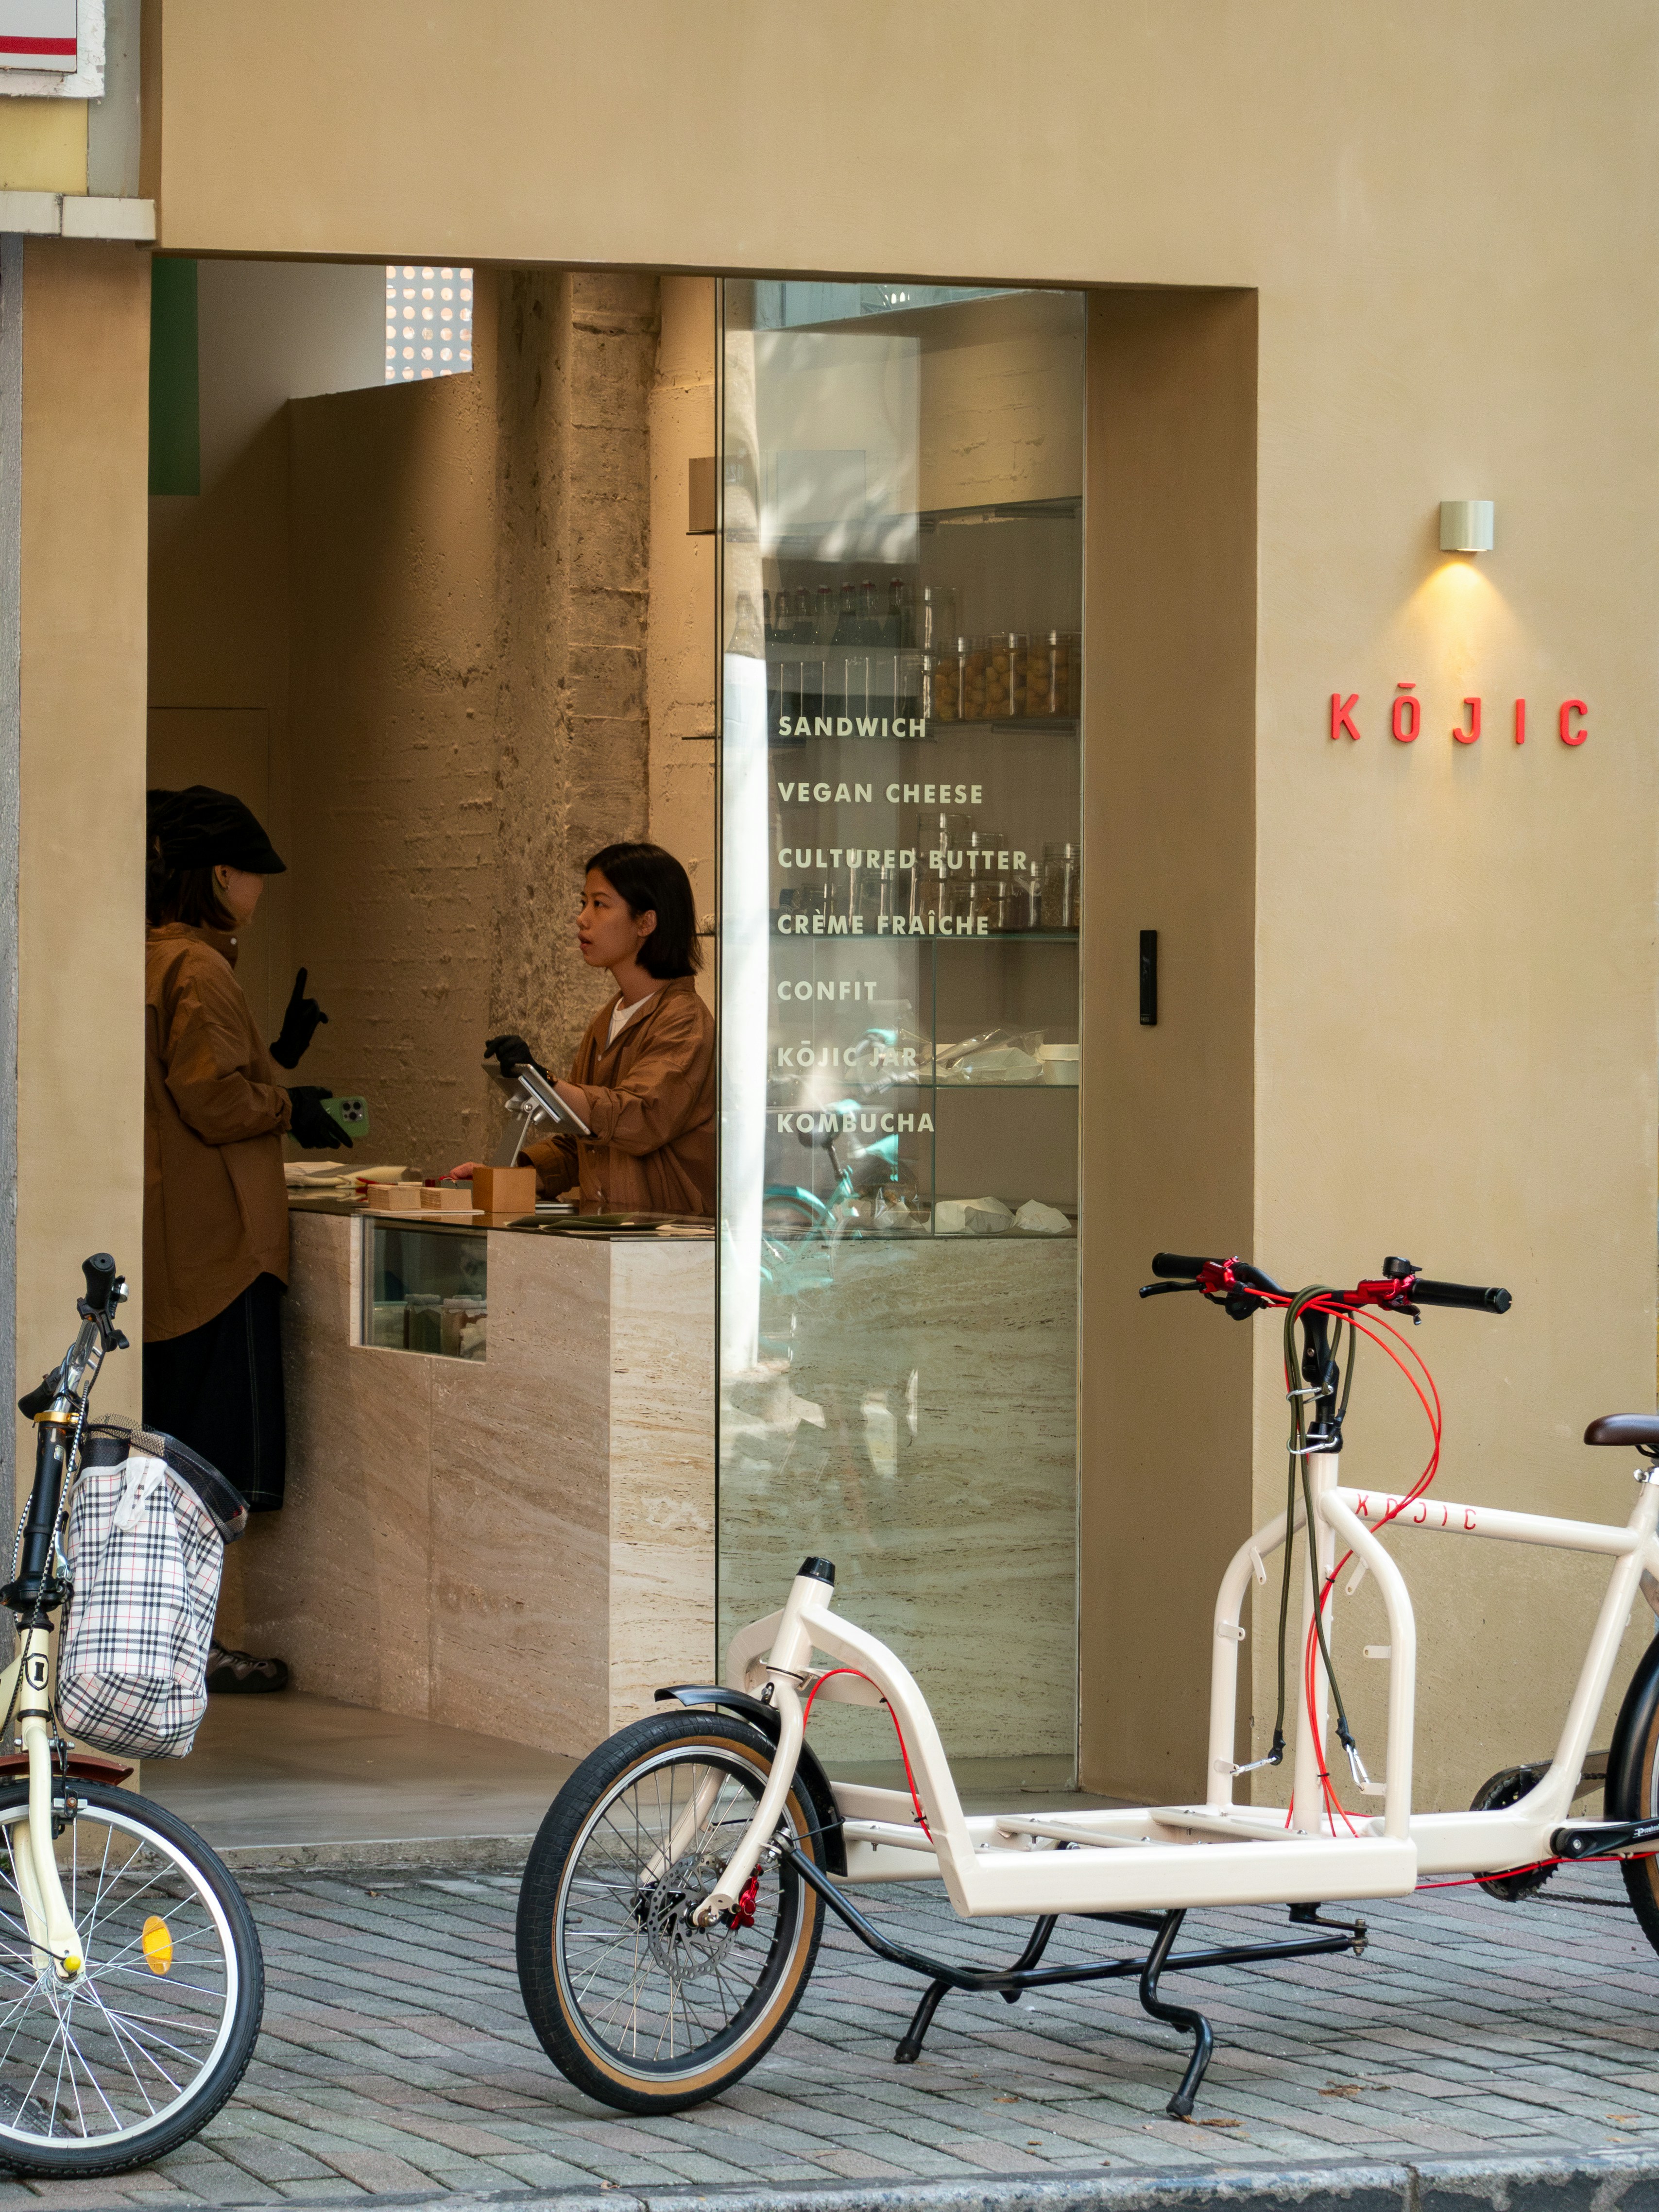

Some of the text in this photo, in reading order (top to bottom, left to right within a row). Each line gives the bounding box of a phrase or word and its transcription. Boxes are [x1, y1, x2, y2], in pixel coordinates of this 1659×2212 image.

[1331, 682, 1588, 746] KŌJIC
[778, 716, 926, 737] SANDWICH
[777, 782, 983, 804] VEGAN CHEESE
[777, 848, 1027, 869] CULTURED BUTTER
[777, 909, 989, 935] CRÈME FRAÎCHE
[777, 981, 876, 1001] CONFIT
[777, 1040, 917, 1067] KŌJIC JAR
[777, 1113, 935, 1133] KOMBUCHA
